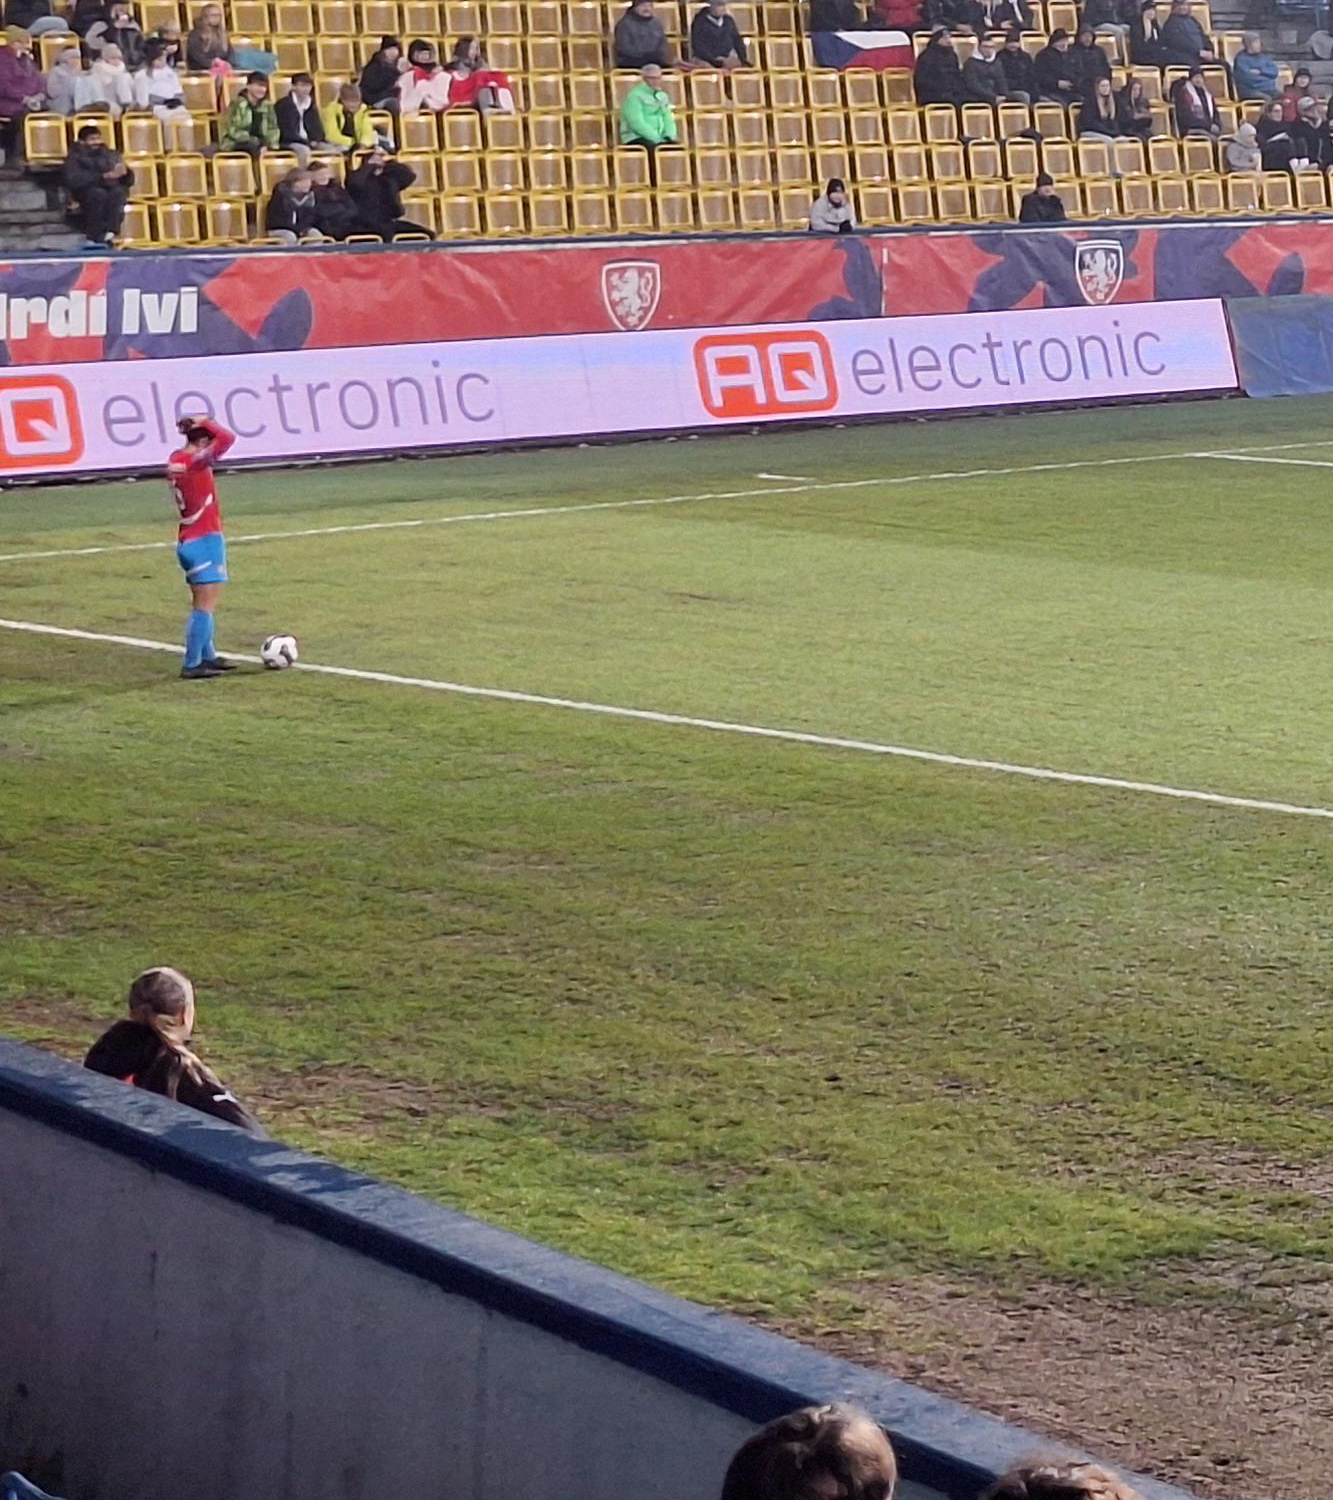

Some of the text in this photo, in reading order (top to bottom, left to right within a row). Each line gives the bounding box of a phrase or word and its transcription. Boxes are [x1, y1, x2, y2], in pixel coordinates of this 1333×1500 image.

[0, 286, 199, 340] rdí lvi
[850, 319, 1167, 396] electronic
